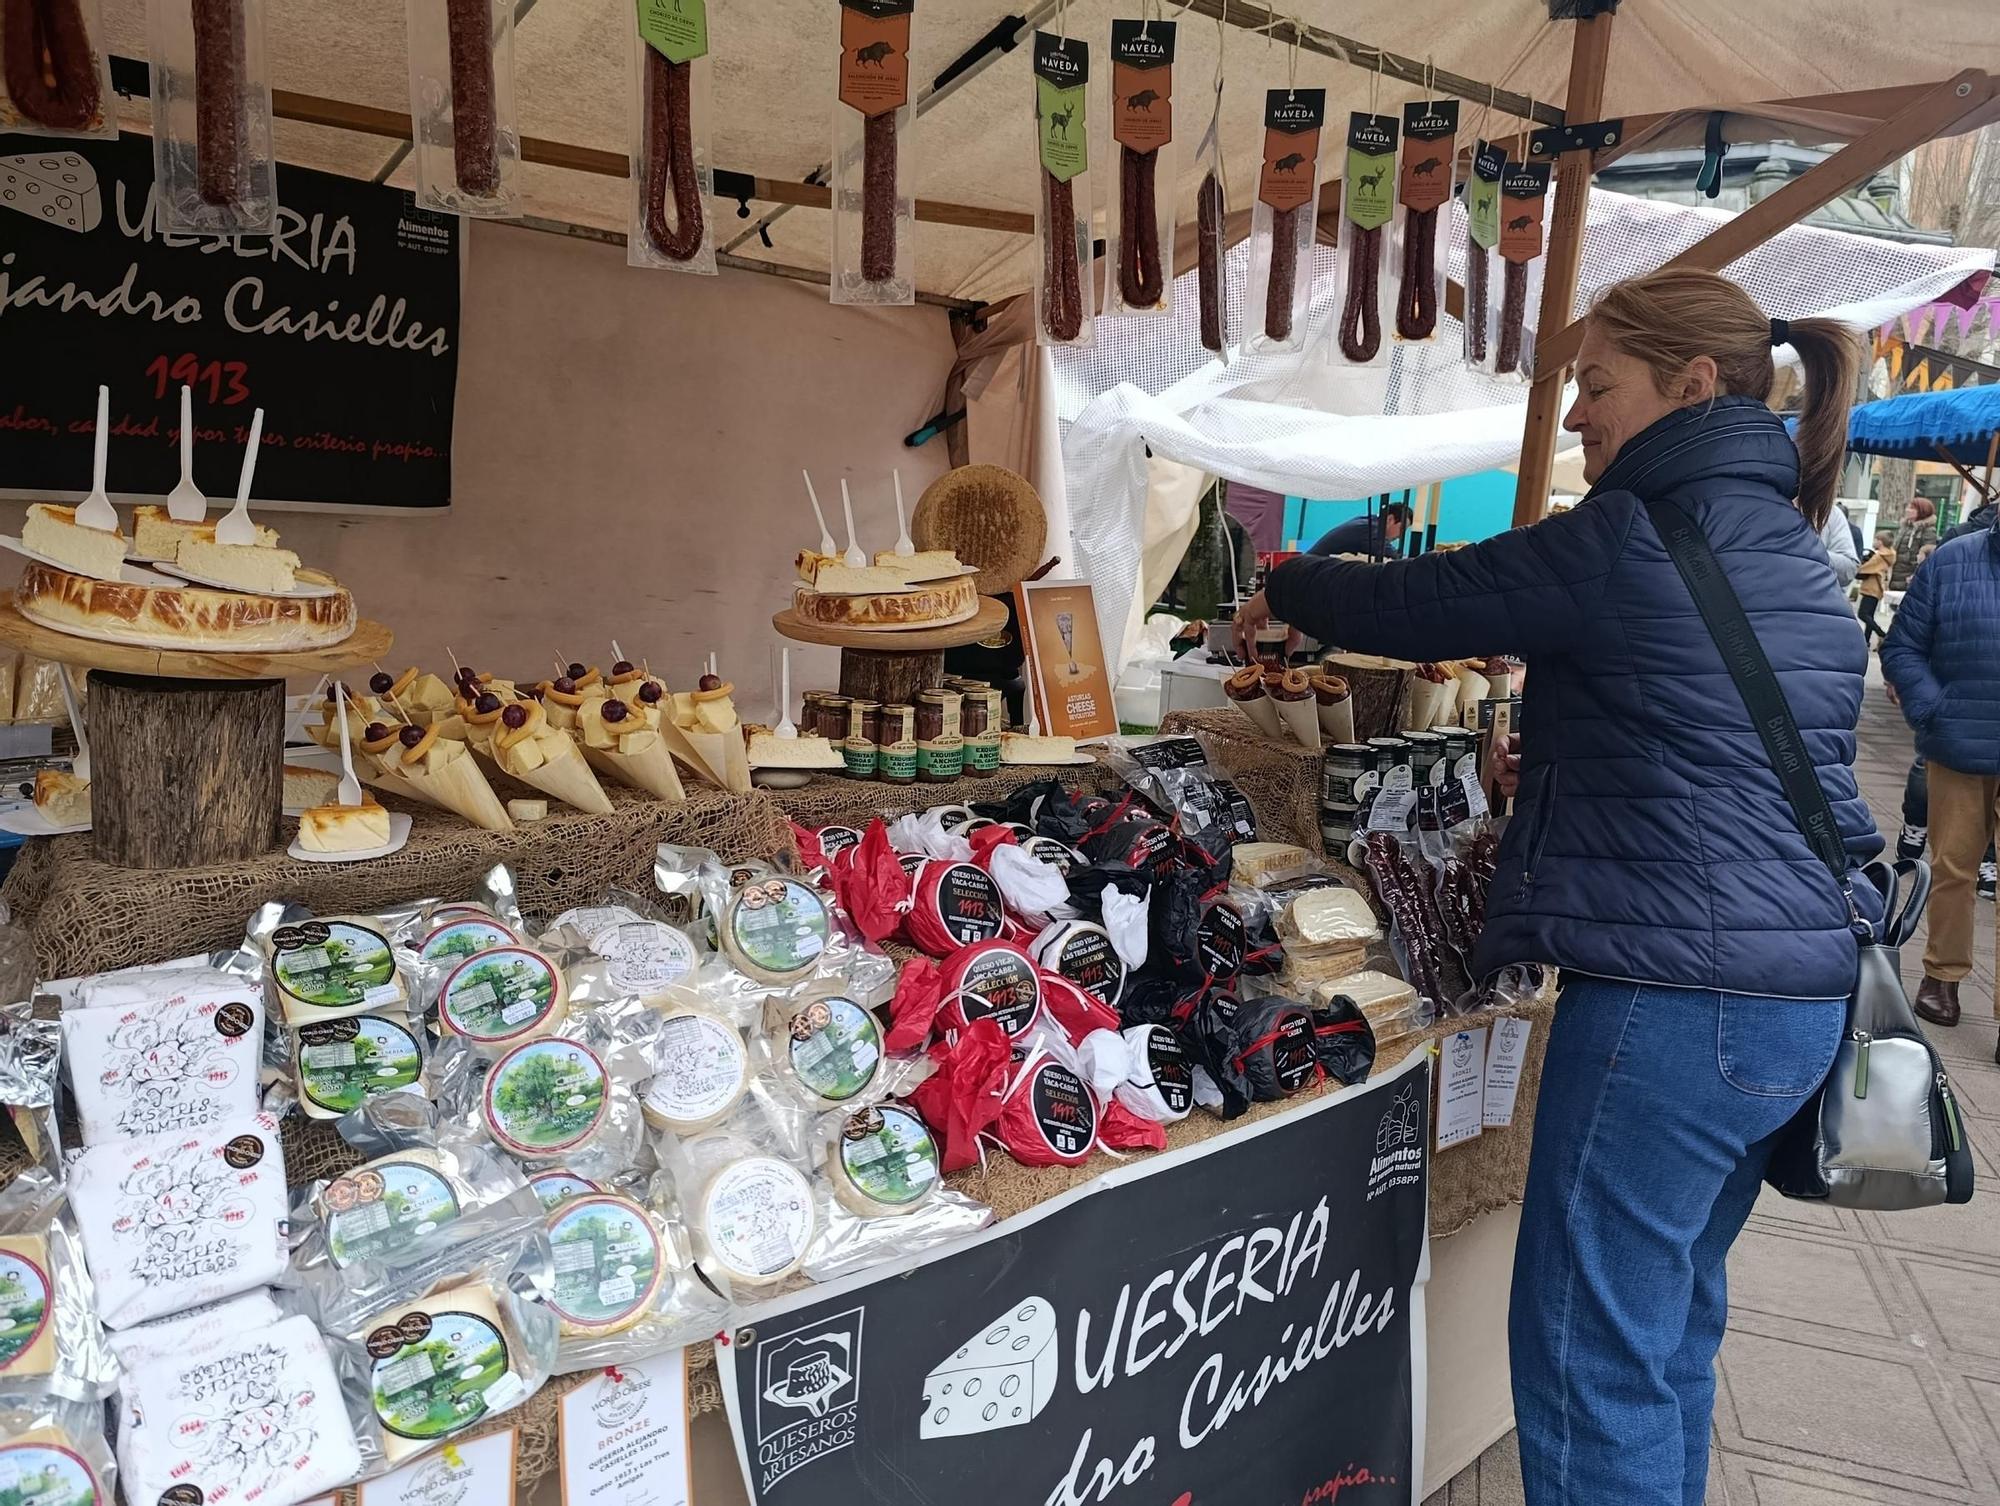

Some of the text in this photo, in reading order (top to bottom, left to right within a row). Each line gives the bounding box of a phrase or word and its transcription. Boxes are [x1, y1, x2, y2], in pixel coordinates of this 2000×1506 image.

[1121, 43, 1164, 54] NAVEDA
[1041, 56, 1079, 71] NAVEDA
[1274, 110, 1314, 118] NAVEDA
[1411, 119, 1449, 128] NAVEDA
[1355, 131, 1390, 143] NAVEDA
[1478, 157, 1498, 172] NAVEDA
[1505, 179, 1541, 187] NAVEDA
[398, 218, 449, 238] Alimentos
[224, 276, 450, 356] Casielles
[146, 353, 250, 405] 1913
[293, 432, 366, 453] criterio
[371, 439, 448, 464] propio...
[1672, 526, 1711, 581] BINNARI
[1722, 616, 1759, 680] BINNARI
[1066, 700, 1096, 713] CHEESE
[1767, 713, 1801, 775] BINNARI
[1157, 831, 1170, 841] VIEJO
[1151, 841, 1167, 852] CABRA
[952, 870, 988, 882] QUESO VIEJO
[952, 878, 989, 890] VACA-CABRA
[953, 887, 989, 900] SELECCIÓN
[958, 900, 985, 918] 1913
[1217, 905, 1231, 918] QUESO
[1221, 916, 1235, 930] CABRA
[1062, 941, 1108, 961] LAS TRES AMIGAS
[1067, 935, 1099, 950] QUESO VIEJO
[973, 956, 1015, 973] QUESO VIEJO
[1071, 952, 1105, 967] SELECCIÓN
[977, 975, 1019, 992] SELECCIÓN
[1080, 965, 1104, 986] 1913
[198, 1002, 217, 1016] 1913
[1294, 1017, 1307, 1027] VIEJO
[1287, 1027, 1303, 1038] CABRA
[208, 1071, 229, 1081] 1913
[1043, 1069, 1078, 1084] QUESO VIEJO
[1043, 1078, 1078, 1093] VACA-CABRA
[1045, 1089, 1079, 1104] SELECCIÓN
[117, 1098, 210, 1127] LAS TRES
[1051, 1102, 1076, 1122] 1913
[254, 1112, 275, 1131] 1913
[1369, 1147, 1422, 1176] Alimentos
[239, 1172, 258, 1186] 1913
[1368, 1173, 1377, 1186] del
[1394, 1160, 1421, 1171] natural
[1366, 1175, 1419, 1202] Nº AUT. 0358PP
[224, 1210, 245, 1222] 1913
[130, 1239, 227, 1273] LAS TRES
[1074, 1195, 1330, 1394] UESERIA
[1178, 1268, 1395, 1450] Casielles
[591, 1378, 652, 1411] WORLD CHEESE
[597, 1418, 652, 1451] BRONZE
[759, 1405, 858, 1466] QUESEROS
[588, 1425, 669, 1470] QUESERIA ALEJANDRO
[600, 1438, 658, 1473] CASIELLES 1913
[762, 1425, 856, 1488] ARTESANOS
[589, 1480, 613, 1497] Queso
[614, 1468, 633, 1482] 1913
[639, 1460, 653, 1469] Las
[653, 1450, 670, 1461] Tres
[617, 1472, 644, 1490] Amigas
[399, 1481, 438, 1502] WORLD
[438, 1467, 475, 1487] CHEESE
